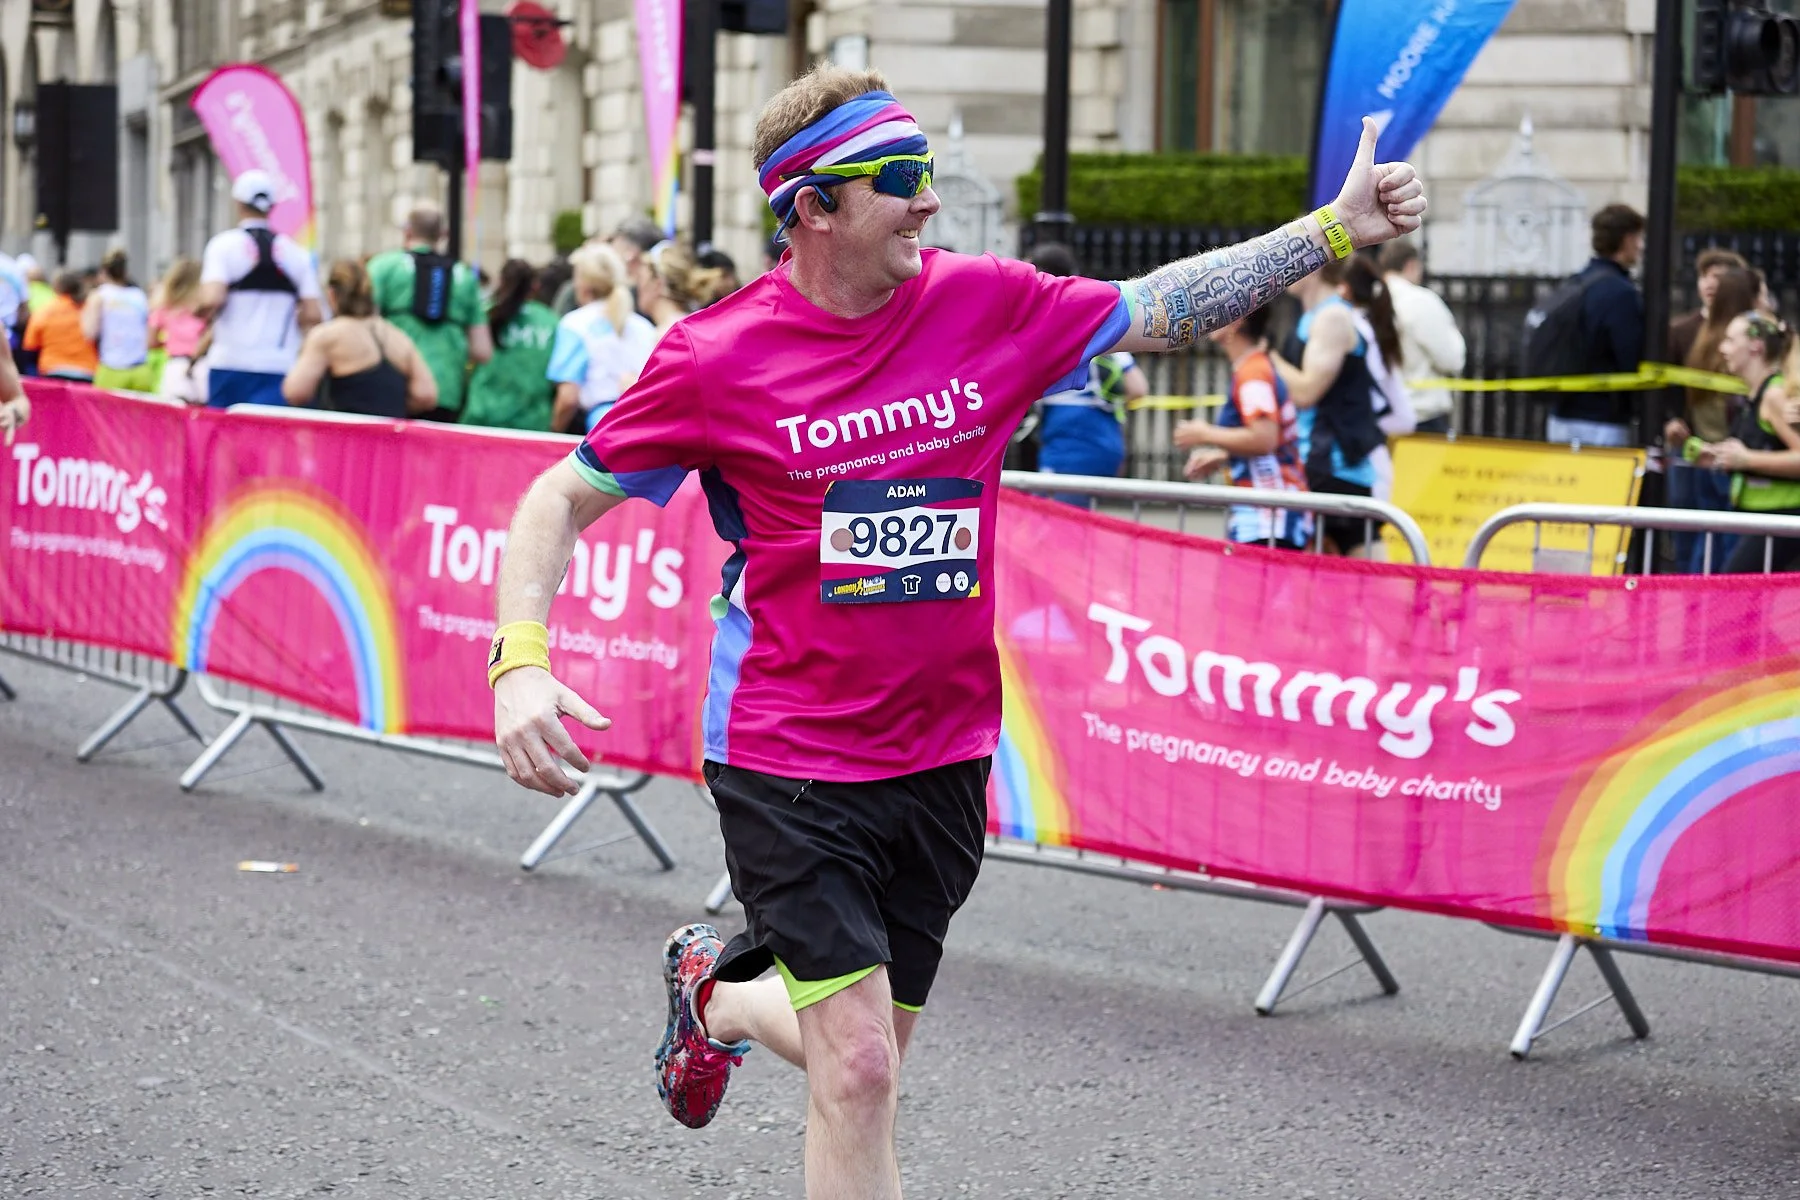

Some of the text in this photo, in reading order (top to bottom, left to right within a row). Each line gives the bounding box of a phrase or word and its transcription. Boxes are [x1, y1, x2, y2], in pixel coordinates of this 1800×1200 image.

[1377, 20, 1440, 99] MOORE
[1175, 293, 1185, 314] 2724
[775, 377, 984, 454] Tommy's
[787, 423, 986, 482] The pregnancy and baby charity
[886, 484, 927, 499] ADAM
[848, 514, 959, 559] 9827
[833, 582, 857, 595] LONDON
[443, 613, 497, 641] pregna
[559, 624, 607, 660] baby
[608, 632, 680, 669] charity
[1087, 602, 1523, 760] Tommy's
[1081, 711, 1502, 811] The pregnancy and baby charity
